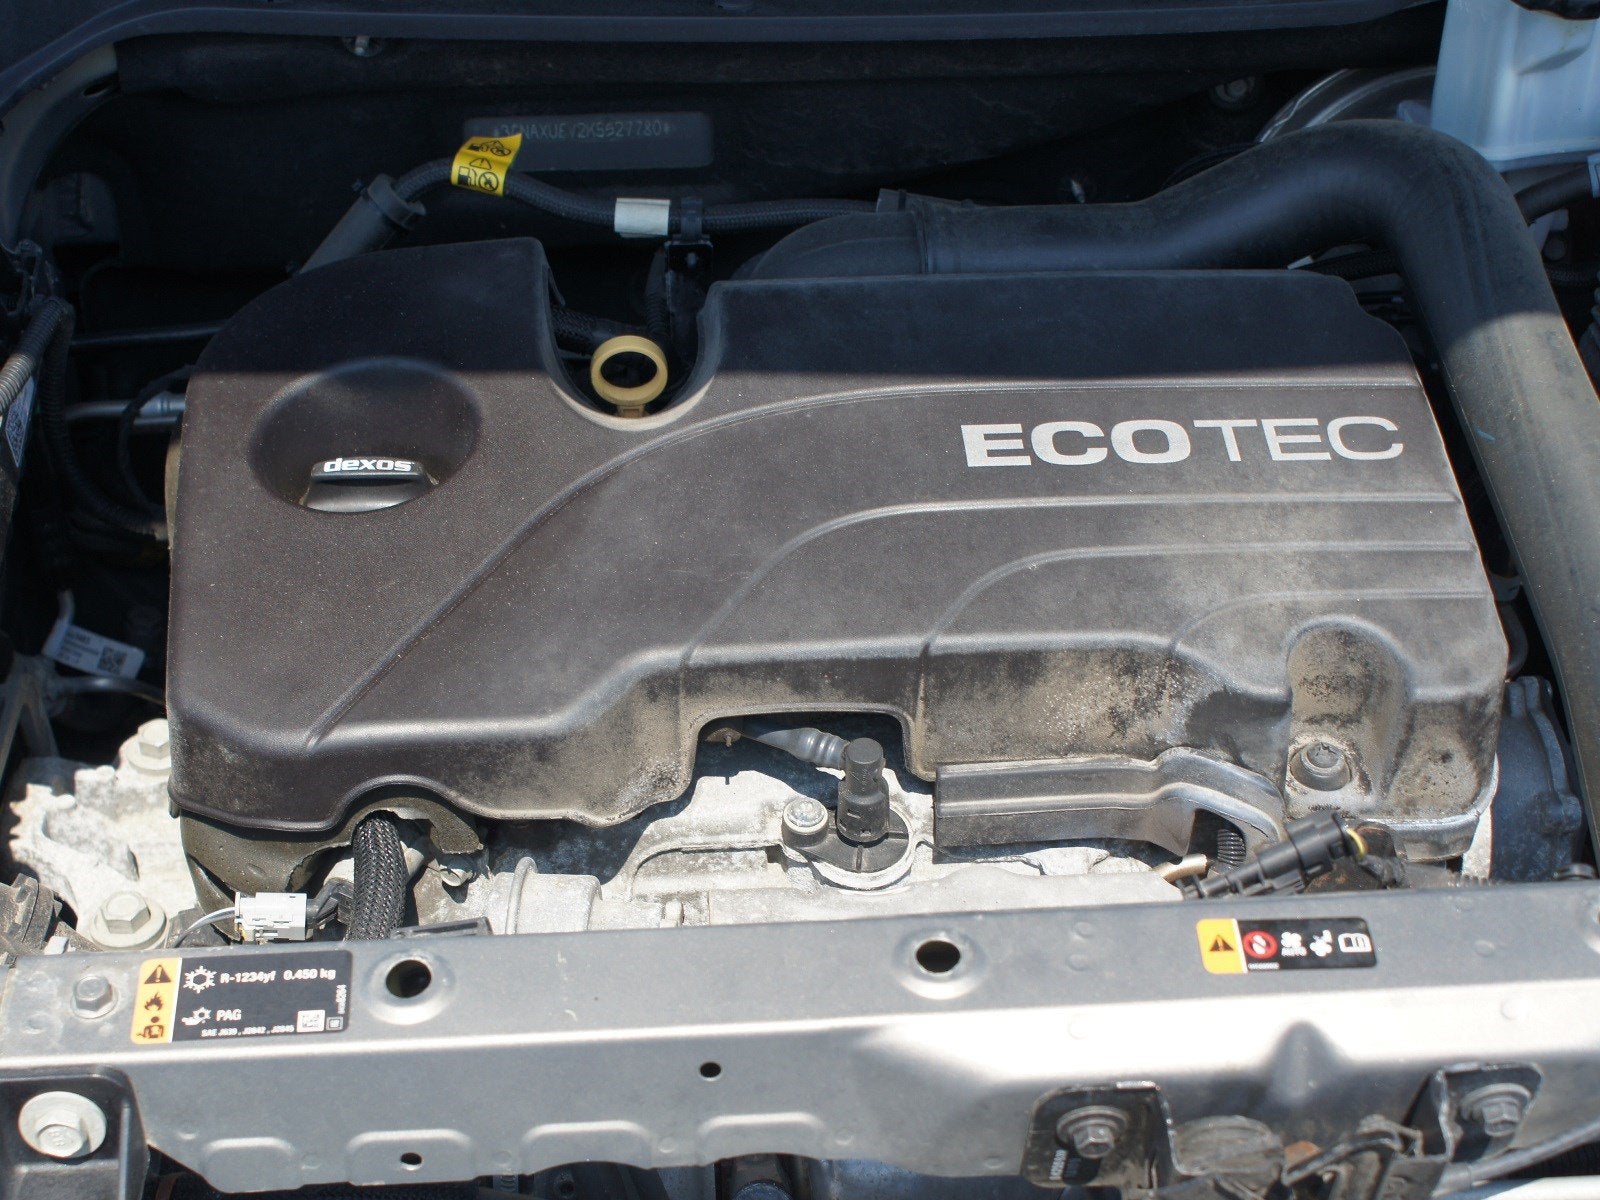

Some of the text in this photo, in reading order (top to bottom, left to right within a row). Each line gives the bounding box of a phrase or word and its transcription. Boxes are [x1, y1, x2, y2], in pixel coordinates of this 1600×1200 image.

[960, 416, 1404, 468] ECOTEC
[323, 457, 413, 473] dexos
[219, 968, 337, 984] R-1234yf 0.450 kg
[216, 1009, 242, 1022] PAG
[201, 1027, 217, 1038] SAE
